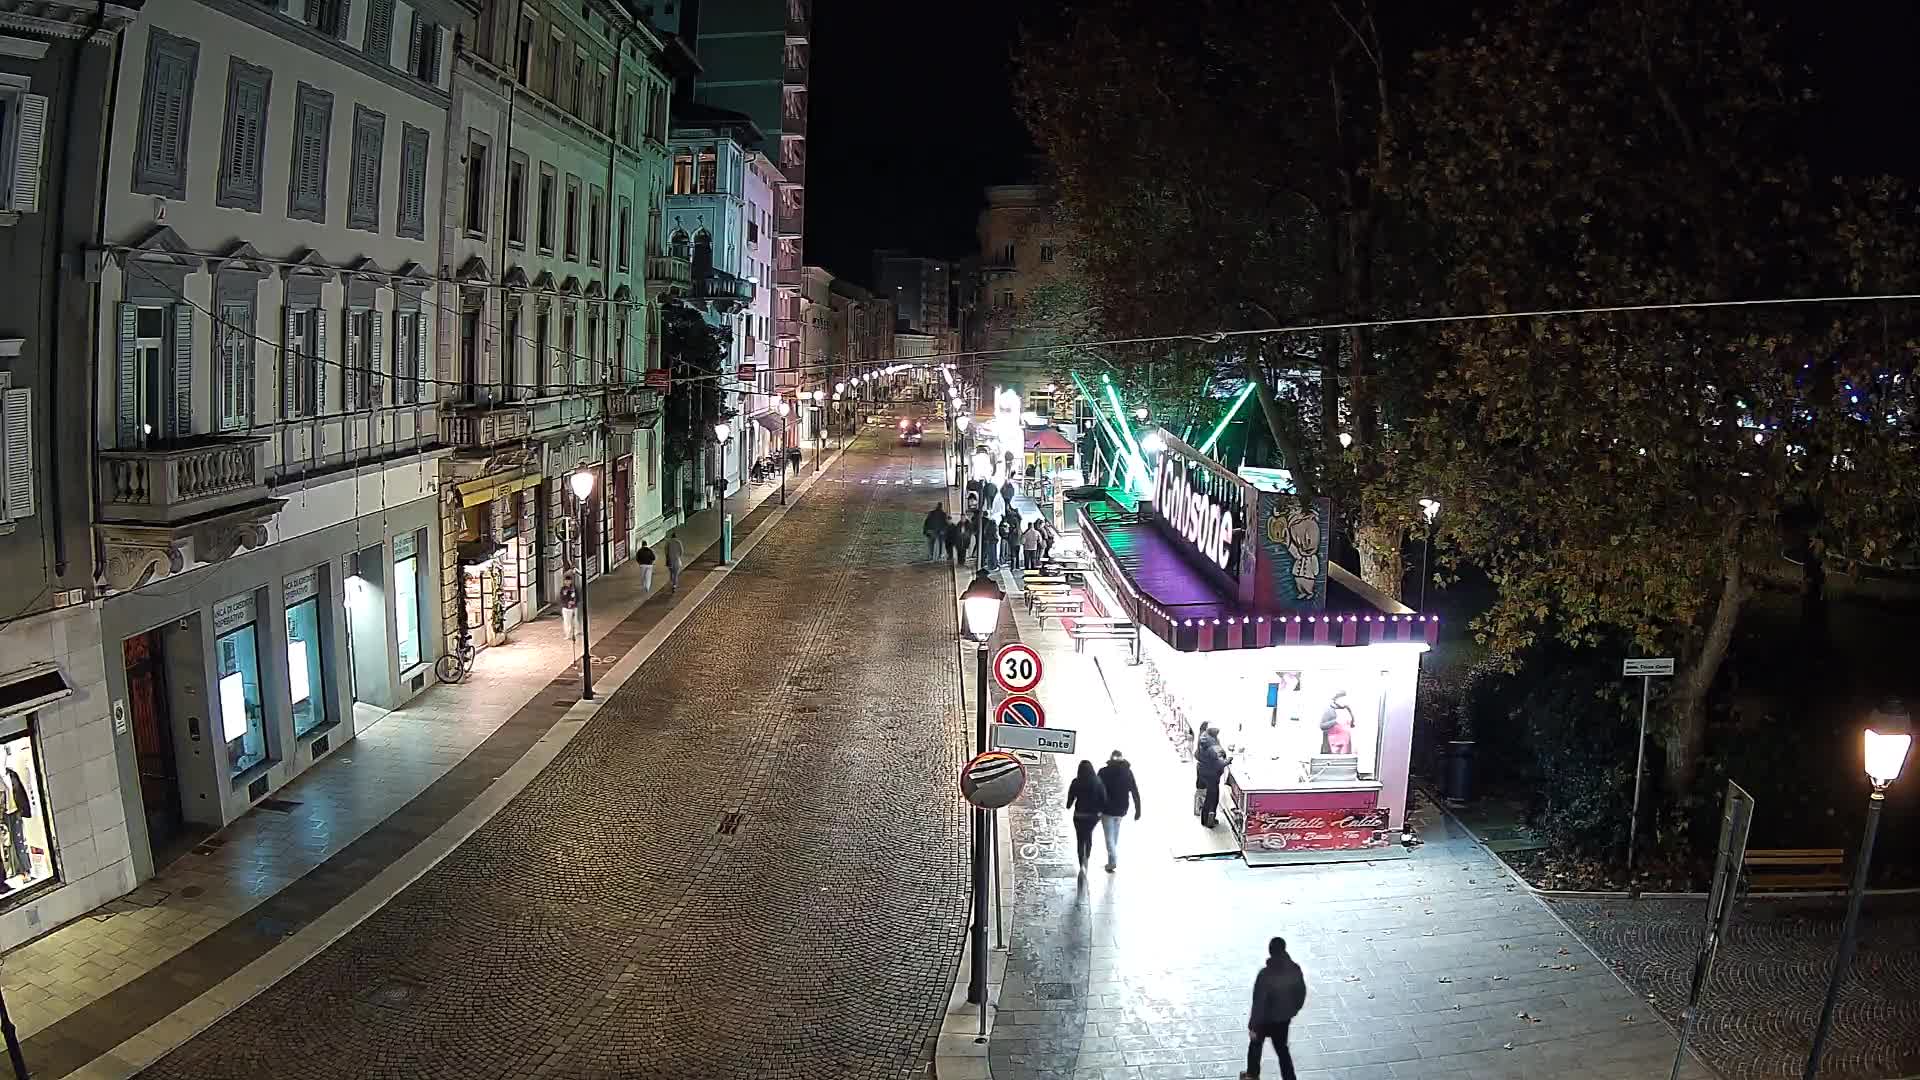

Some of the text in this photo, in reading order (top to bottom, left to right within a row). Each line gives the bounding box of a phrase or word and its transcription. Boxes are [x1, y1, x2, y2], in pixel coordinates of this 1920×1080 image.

[1161, 455, 1233, 570] Golosone
[1005, 657, 1032, 680] 30
[1038, 737, 1069, 749] Dante
